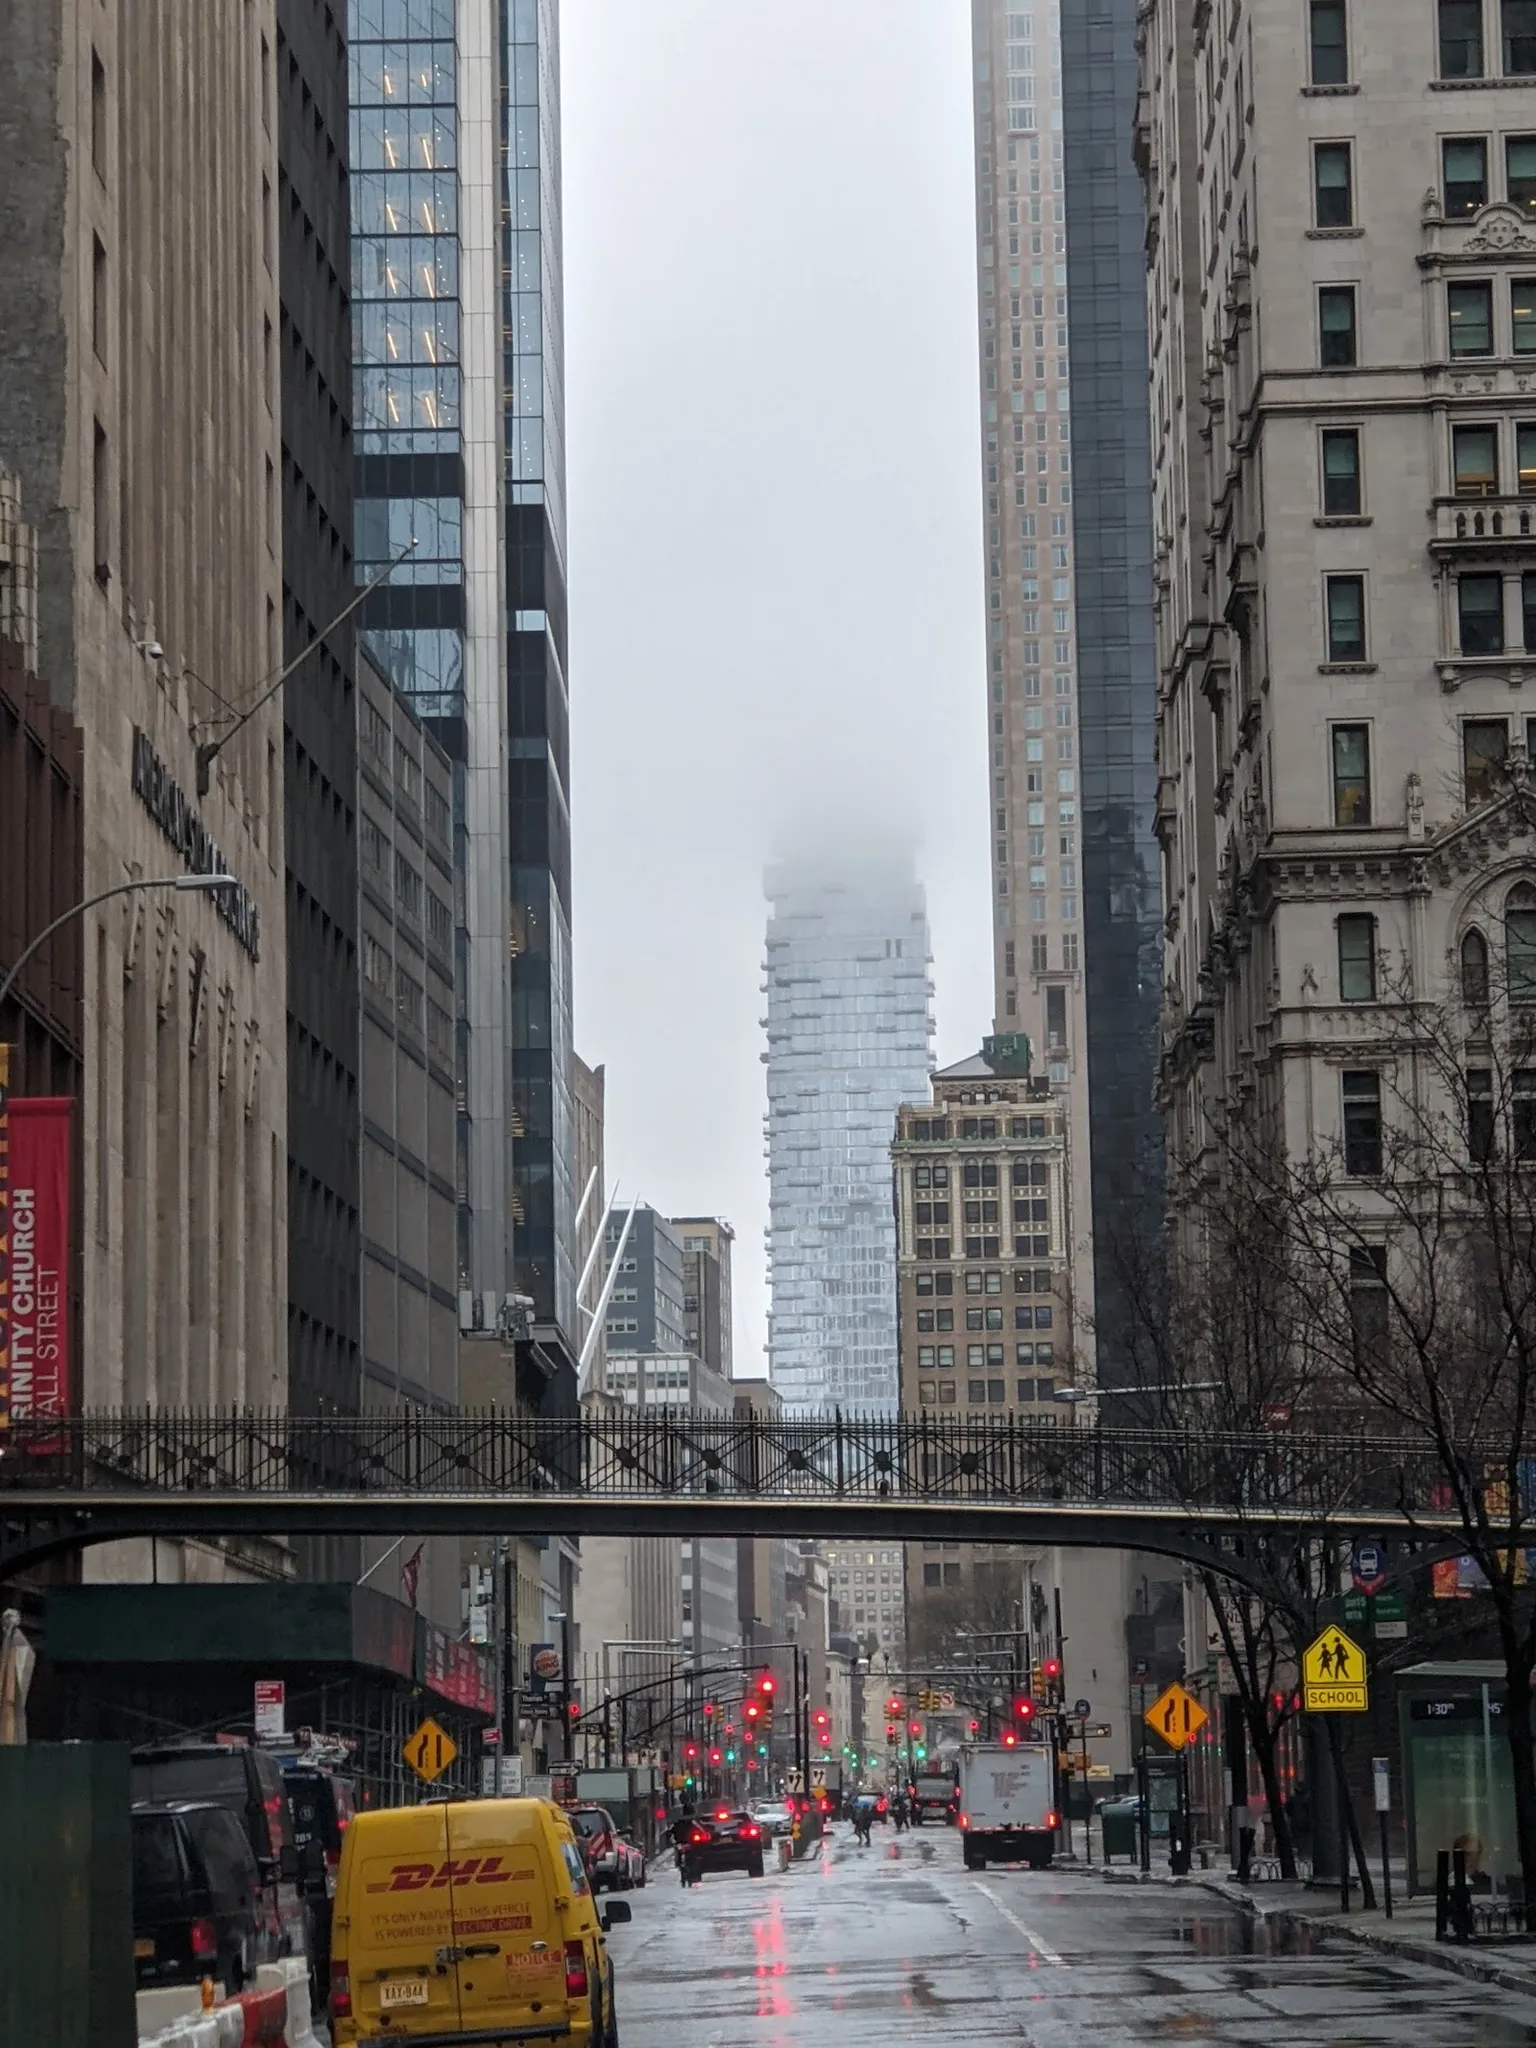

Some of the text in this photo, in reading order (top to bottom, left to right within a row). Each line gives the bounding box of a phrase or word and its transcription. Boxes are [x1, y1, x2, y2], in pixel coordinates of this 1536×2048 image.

[11, 1188, 36, 1424] RINITY CHURCH
[37, 1264, 59, 1360] STREET
[1309, 1691, 1363, 1704] SCHOOL
[390, 1856, 513, 1892] DHL
[391, 1911, 417, 1924] ONLY
[511, 1950, 556, 1966] NOTICE
